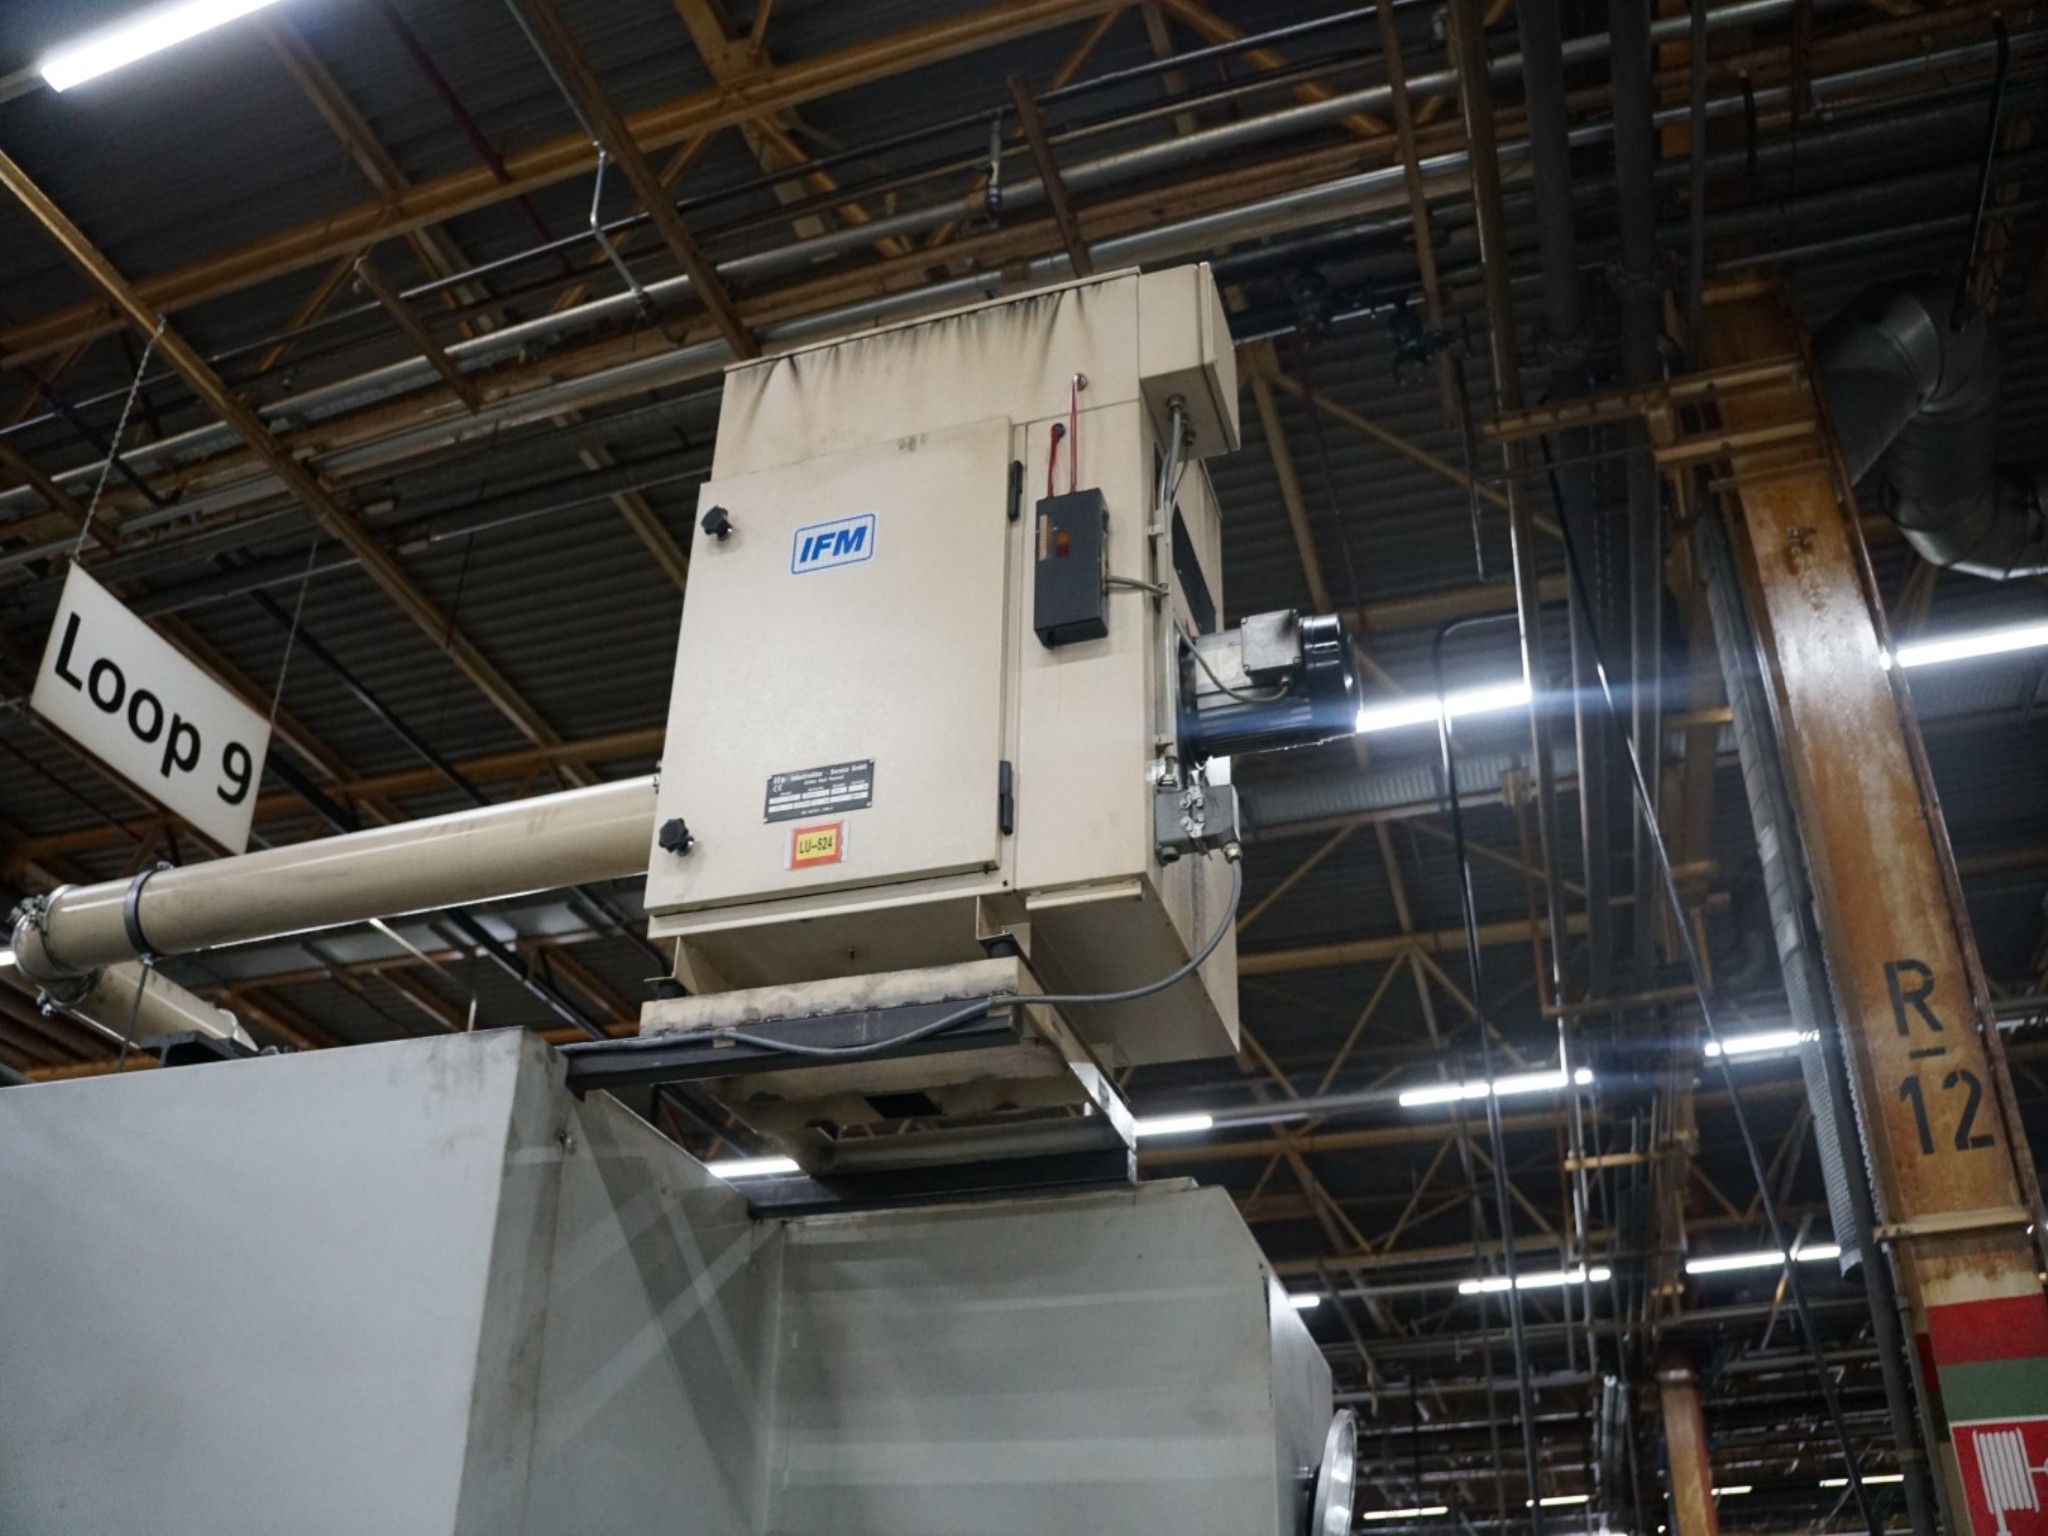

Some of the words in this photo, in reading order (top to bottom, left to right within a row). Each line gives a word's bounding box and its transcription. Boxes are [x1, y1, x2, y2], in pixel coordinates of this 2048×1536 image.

[799, 525, 867, 563] IFM
[54, 611, 201, 778] Loop
[216, 741, 253, 806] 9
[799, 836, 833, 854] LU-524
[1883, 958, 1943, 1037] R
[1899, 1069, 1995, 1155] 12
